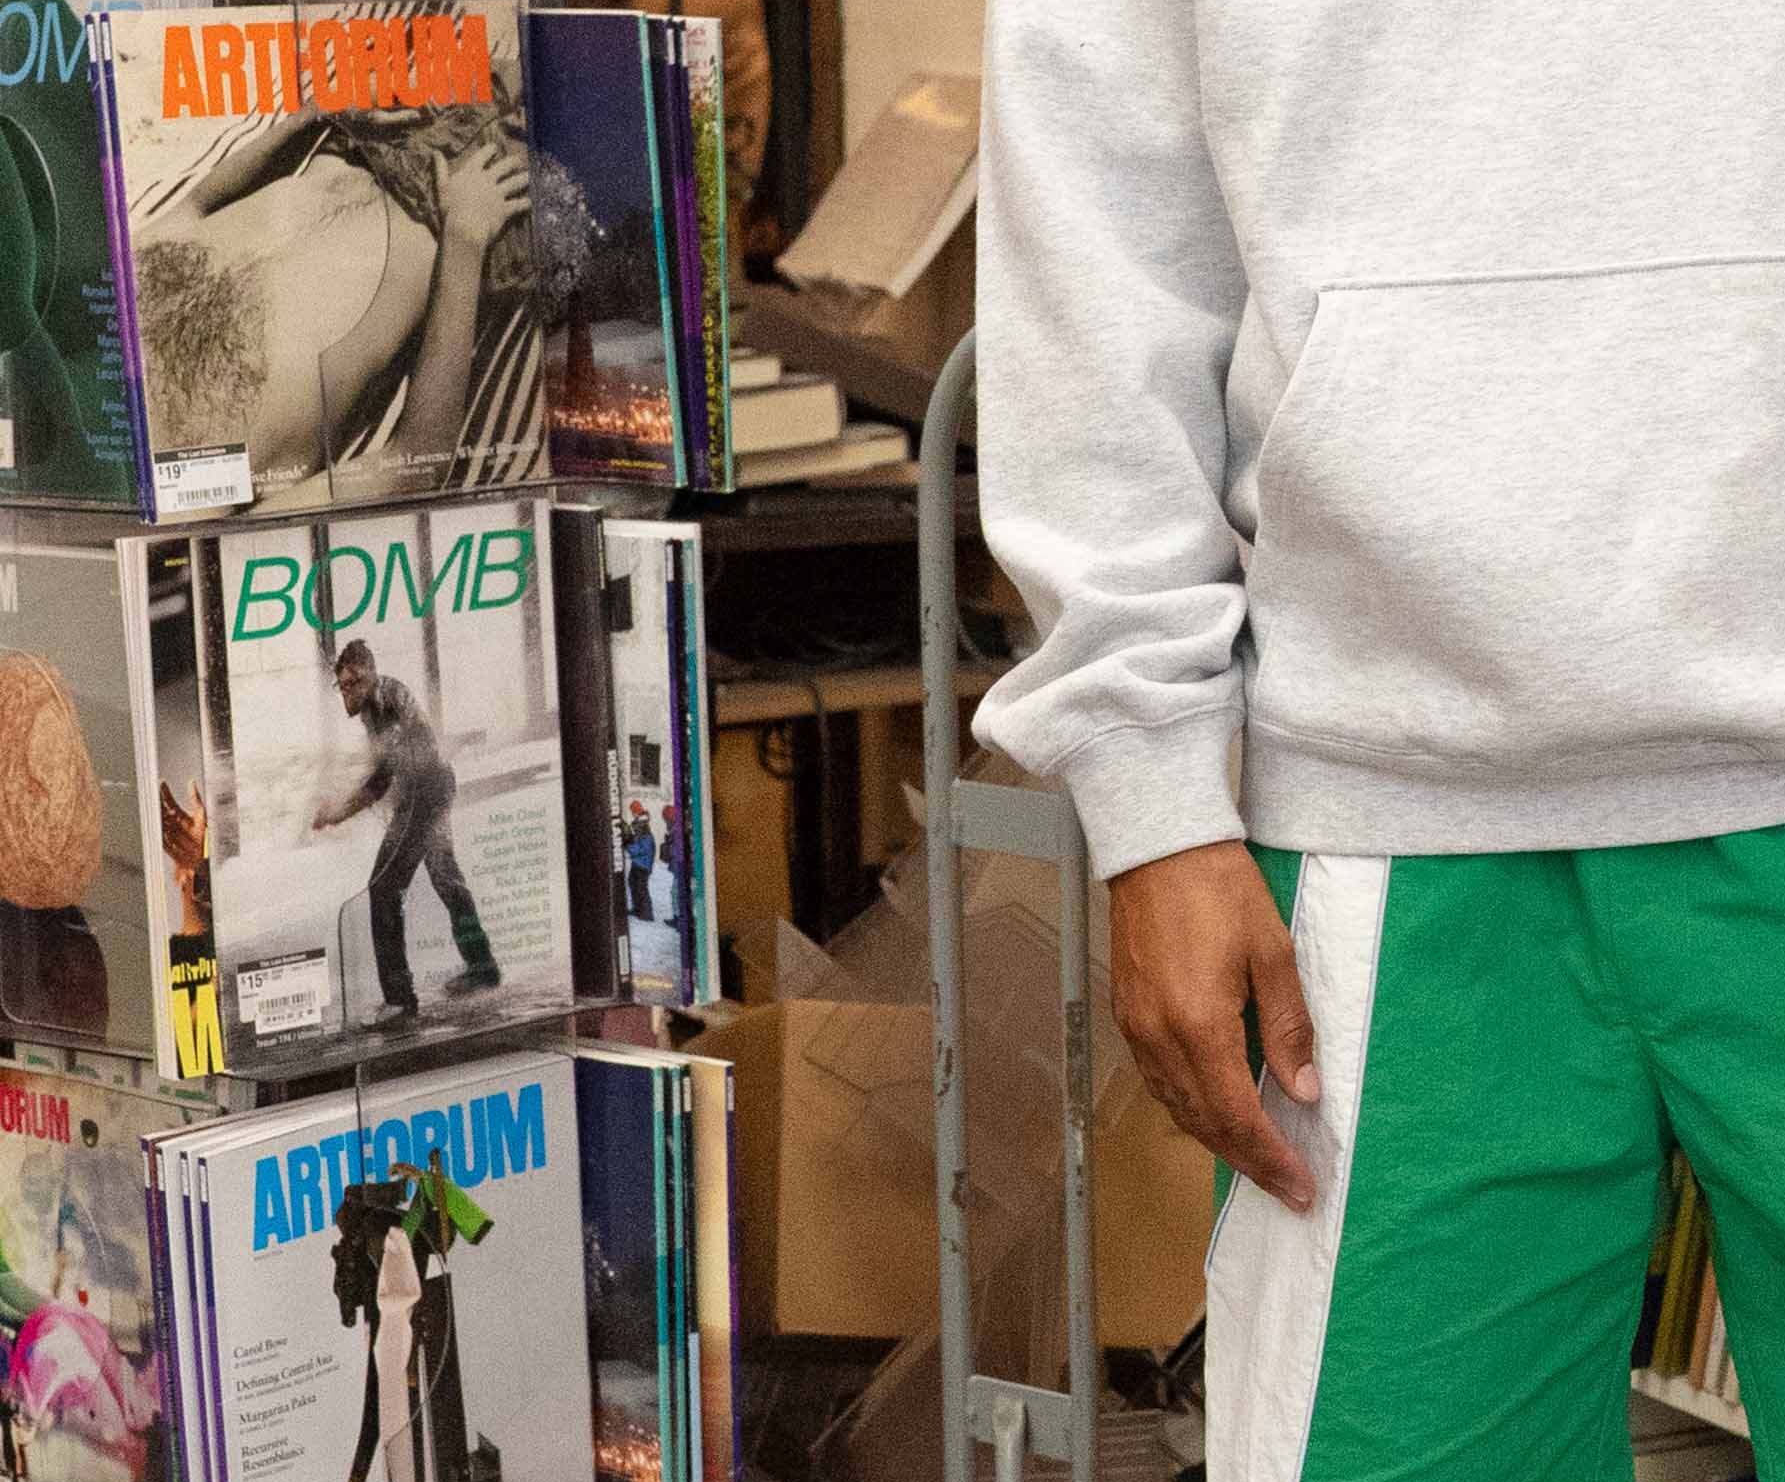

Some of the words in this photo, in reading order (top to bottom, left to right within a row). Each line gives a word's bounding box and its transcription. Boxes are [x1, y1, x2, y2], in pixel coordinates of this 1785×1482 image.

[161, 13, 493, 119] ARTFORUM
[232, 527, 535, 643] BOMB
[252, 1082, 546, 1252] ARTFORUM
